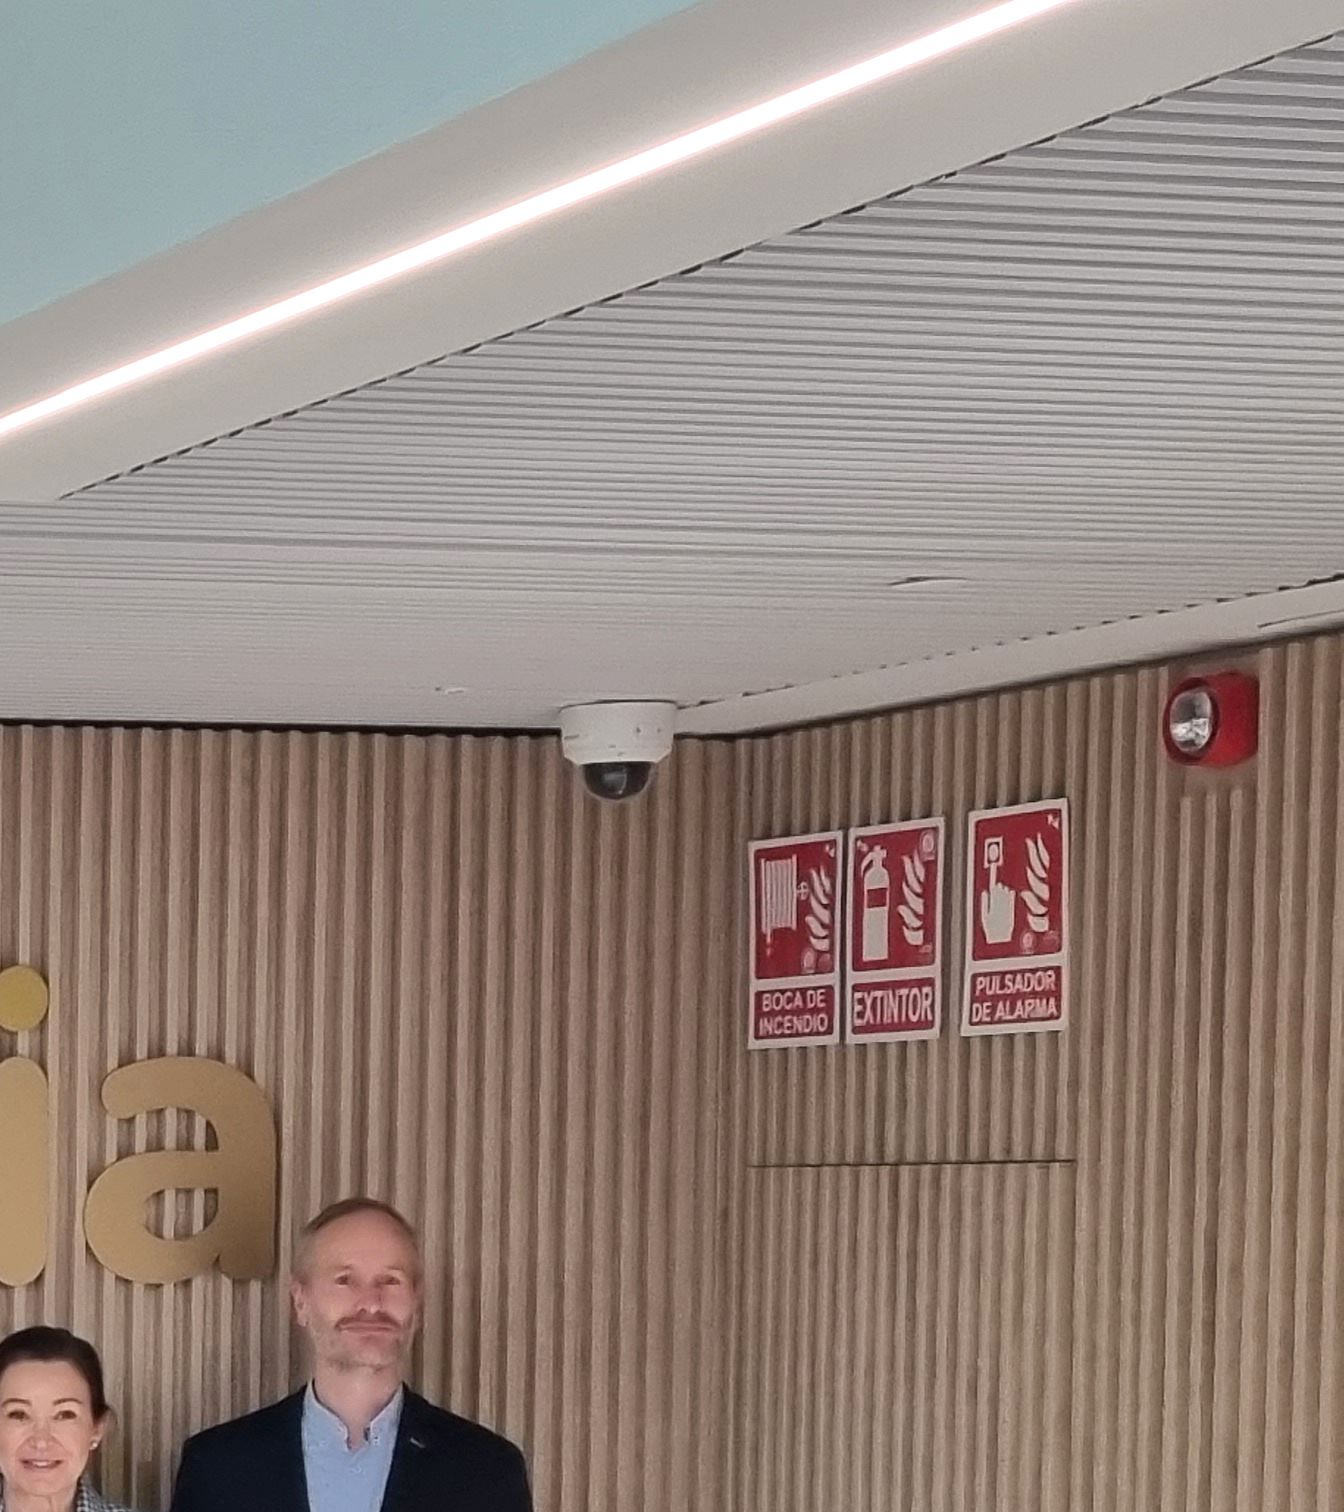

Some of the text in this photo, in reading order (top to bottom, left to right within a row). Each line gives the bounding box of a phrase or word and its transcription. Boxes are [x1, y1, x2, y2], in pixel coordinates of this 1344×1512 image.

[975, 969, 1056, 996] PULSADOR
[762, 988, 826, 1012] BOCA DE
[853, 986, 933, 1027] EXTINTOR
[972, 997, 1058, 1023] DE ALARMA
[759, 1013, 828, 1037] INCENDIO
